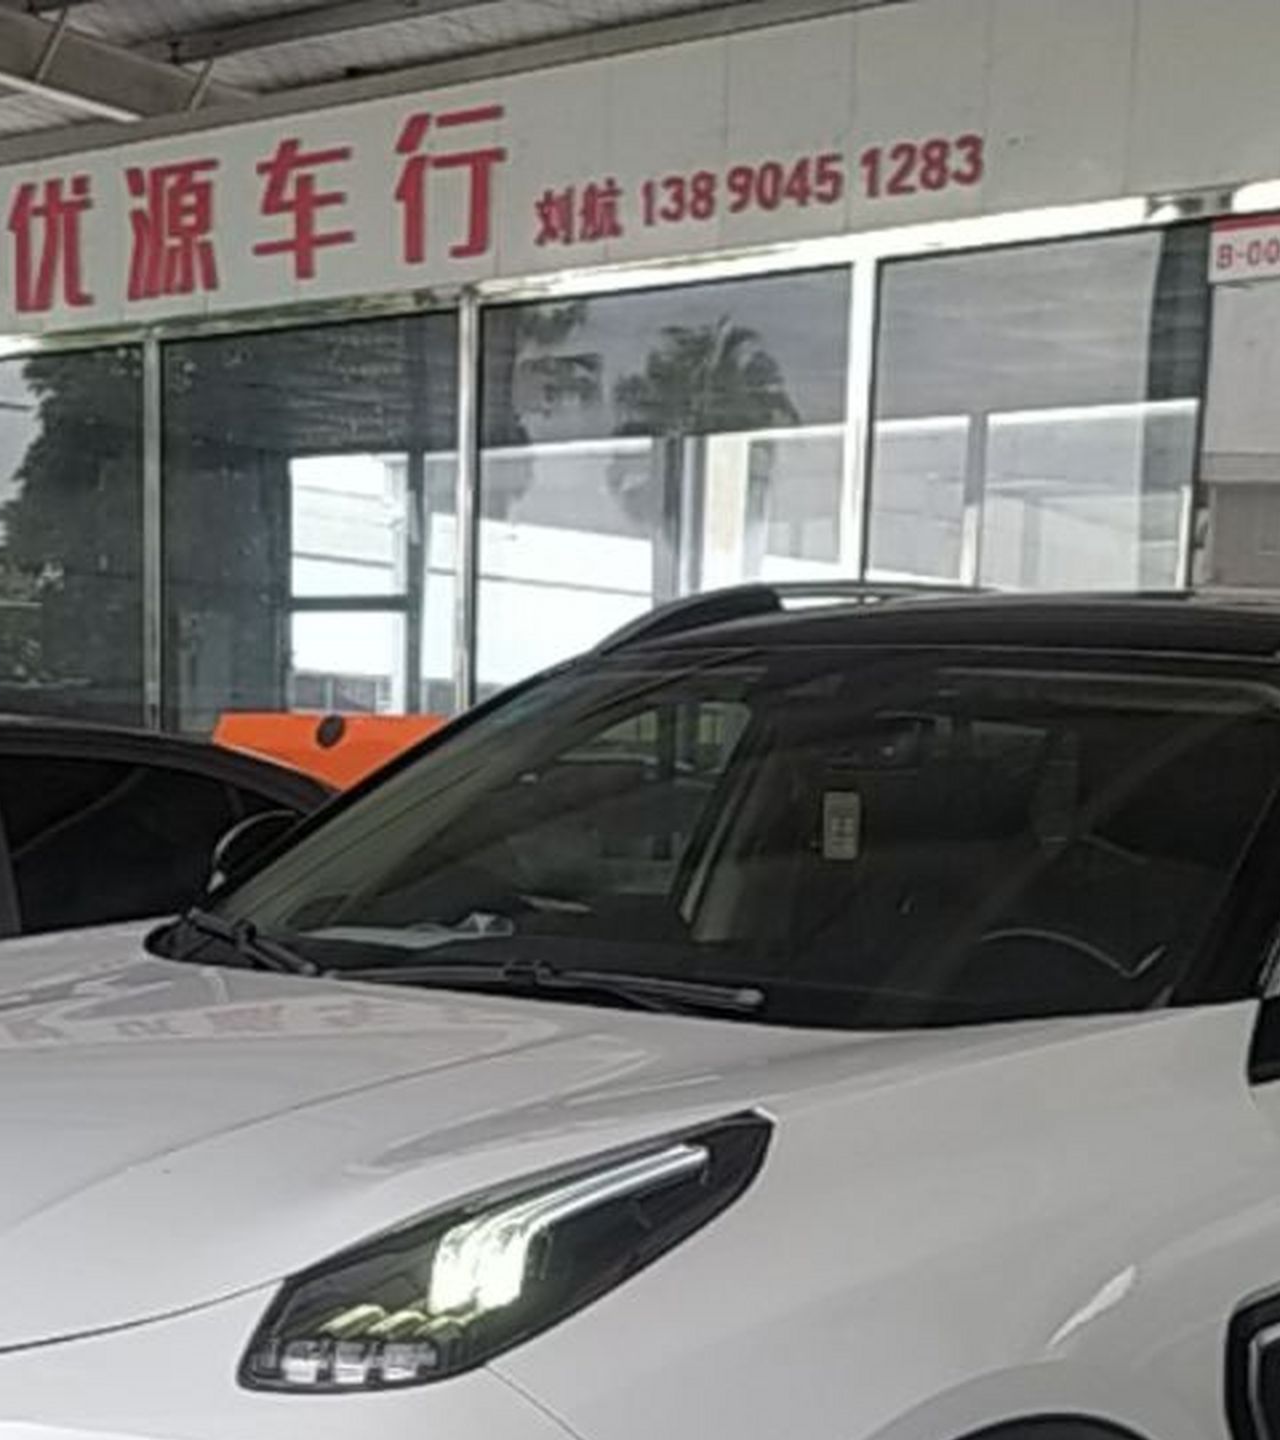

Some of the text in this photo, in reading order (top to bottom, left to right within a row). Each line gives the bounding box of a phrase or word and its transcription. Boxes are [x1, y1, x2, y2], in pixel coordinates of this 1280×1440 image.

[6, 105, 508, 313] 优源车行
[534, 178, 624, 246] 刘航
